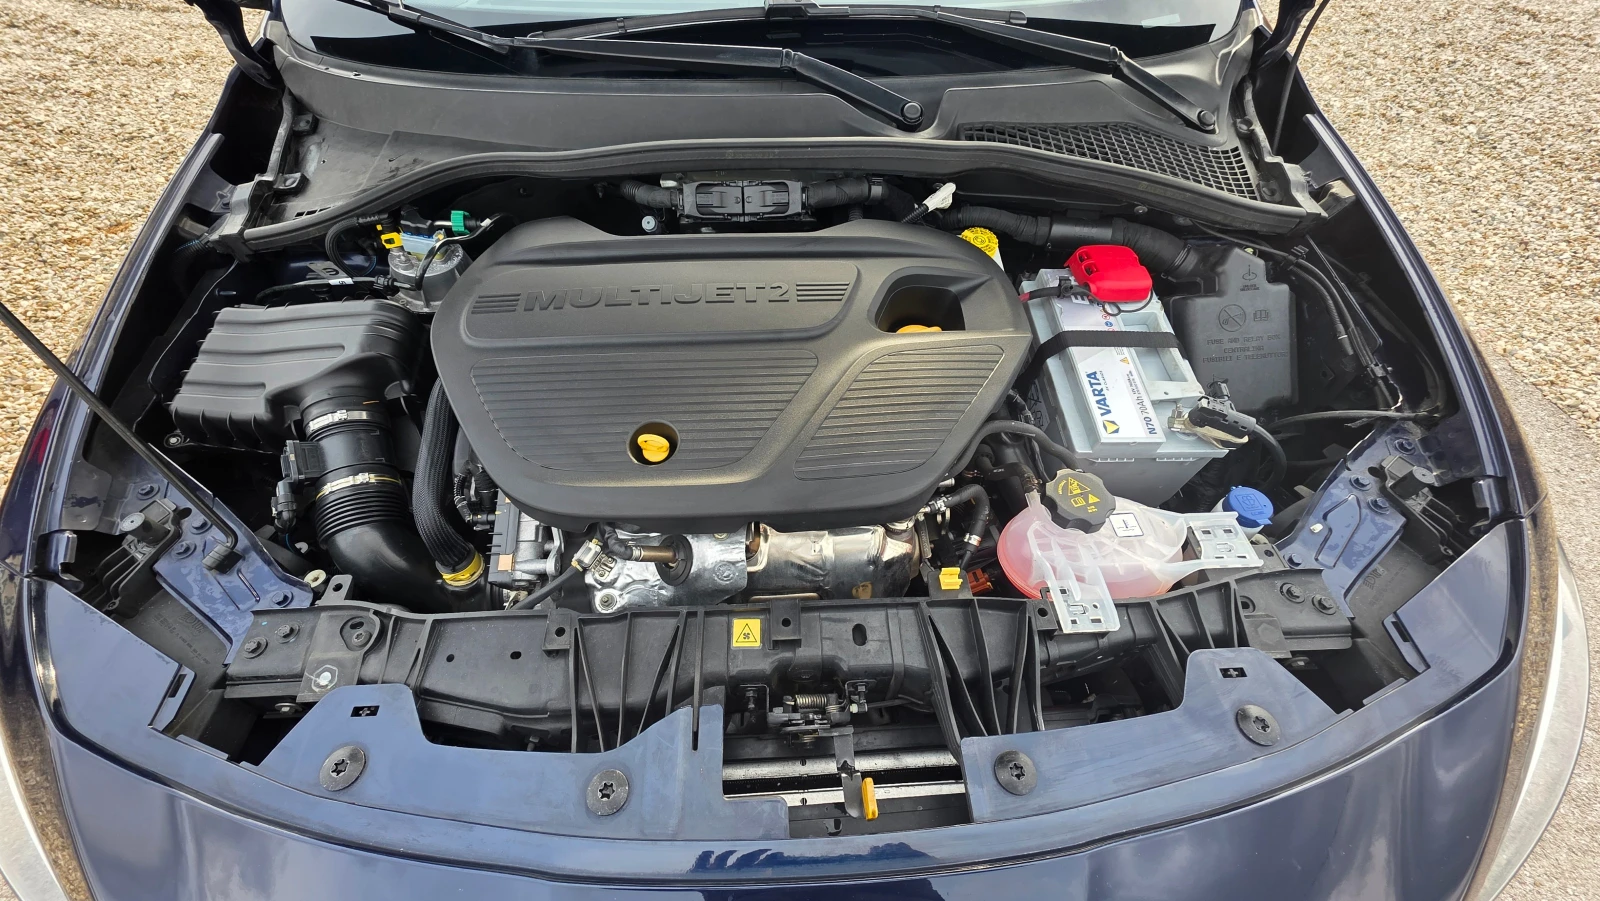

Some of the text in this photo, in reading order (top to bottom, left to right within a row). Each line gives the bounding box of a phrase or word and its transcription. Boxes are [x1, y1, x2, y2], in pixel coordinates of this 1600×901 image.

[1206, 338, 1225, 346] FUSE
[1243, 335, 1264, 343] RELAY
[1085, 370, 1112, 417] VARTA
[1135, 395, 1150, 416] 70Ah
[1143, 416, 1158, 435] N70
